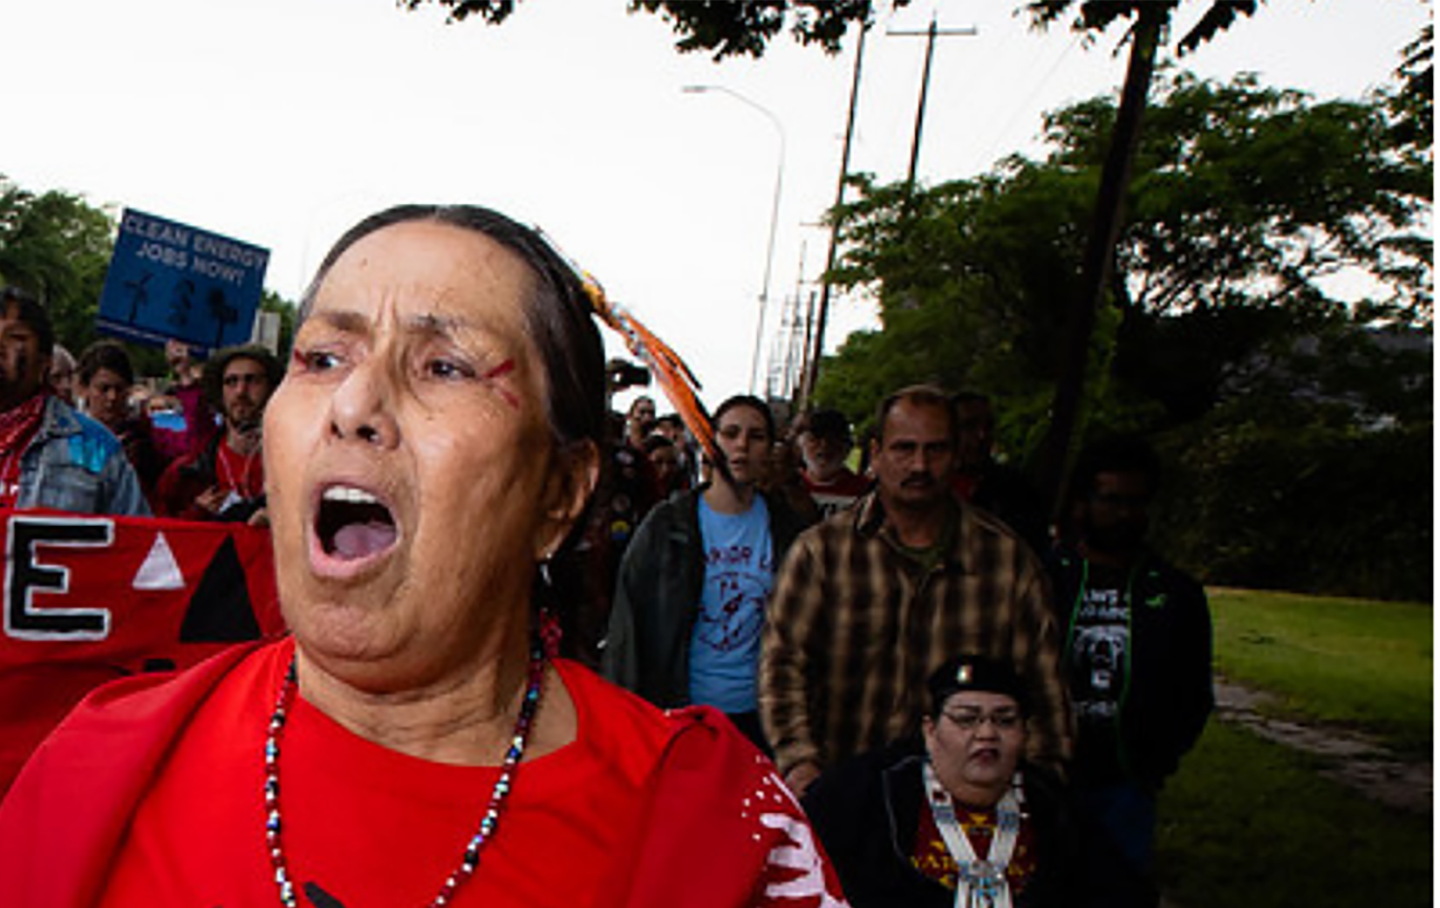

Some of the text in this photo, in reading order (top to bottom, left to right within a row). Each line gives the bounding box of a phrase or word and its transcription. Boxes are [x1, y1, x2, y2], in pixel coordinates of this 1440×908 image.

[125, 214, 266, 268] CLEAN ENERGY
[136, 241, 188, 270] JOBS
